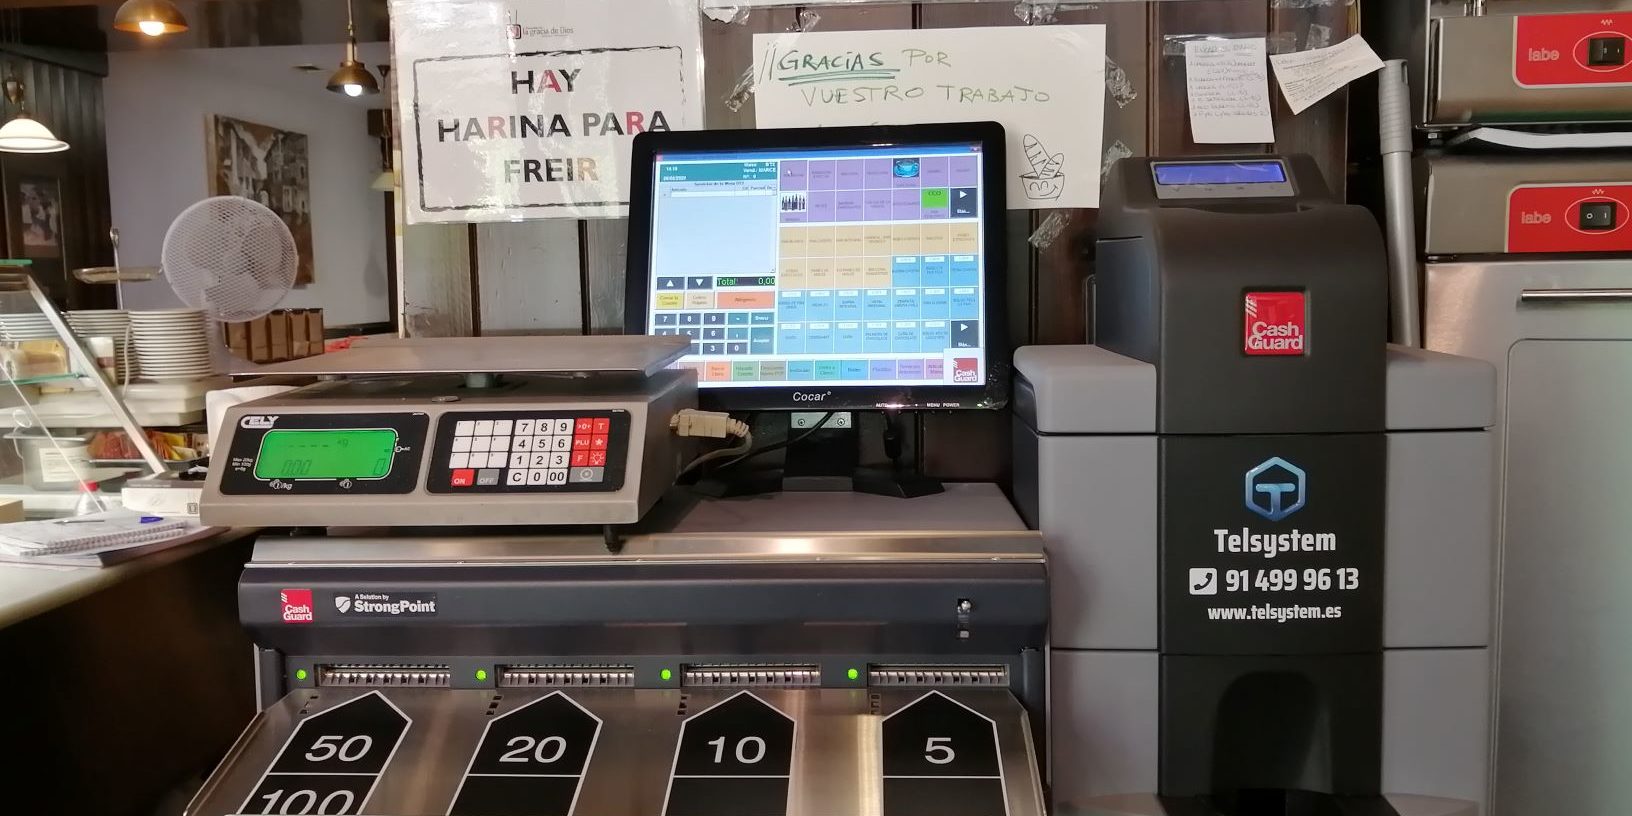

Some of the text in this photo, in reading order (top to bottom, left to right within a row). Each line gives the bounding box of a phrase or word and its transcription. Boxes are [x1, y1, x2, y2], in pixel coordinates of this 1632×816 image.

[511, 68, 581, 95] HAY
[801, 84, 1052, 107] VUESTRO TRABAJO
[438, 110, 672, 142] HARINA PARA
[504, 157, 600, 183] FREIR
[1252, 321, 1300, 336] Cash
[1248, 335, 1303, 350] Guard
[521, 423, 528, 432] 7
[541, 423, 548, 432] 8
[560, 423, 568, 432] 9
[518, 440, 526, 448] 4
[538, 440, 546, 448] 5
[558, 440, 566, 448] 6
[517, 456, 523, 465] 1
[536, 456, 544, 465] 2
[556, 456, 563, 465] 3
[512, 472, 522, 482] C
[534, 472, 541, 482] 0
[549, 472, 564, 481] 00
[1214, 527, 1336, 558] Telsystem
[1226, 567, 1359, 592] 91 499 96 13
[284, 604, 309, 614] Cash
[354, 600, 436, 615] StrongPoint
[1208, 603, 1342, 623] www.telsystem.es
[283, 611, 313, 621] Guard
[304, 735, 373, 763] 50
[499, 735, 568, 763] 20
[707, 736, 767, 764] 10
[924, 736, 956, 765] 5
[261, 789, 356, 816] 100
